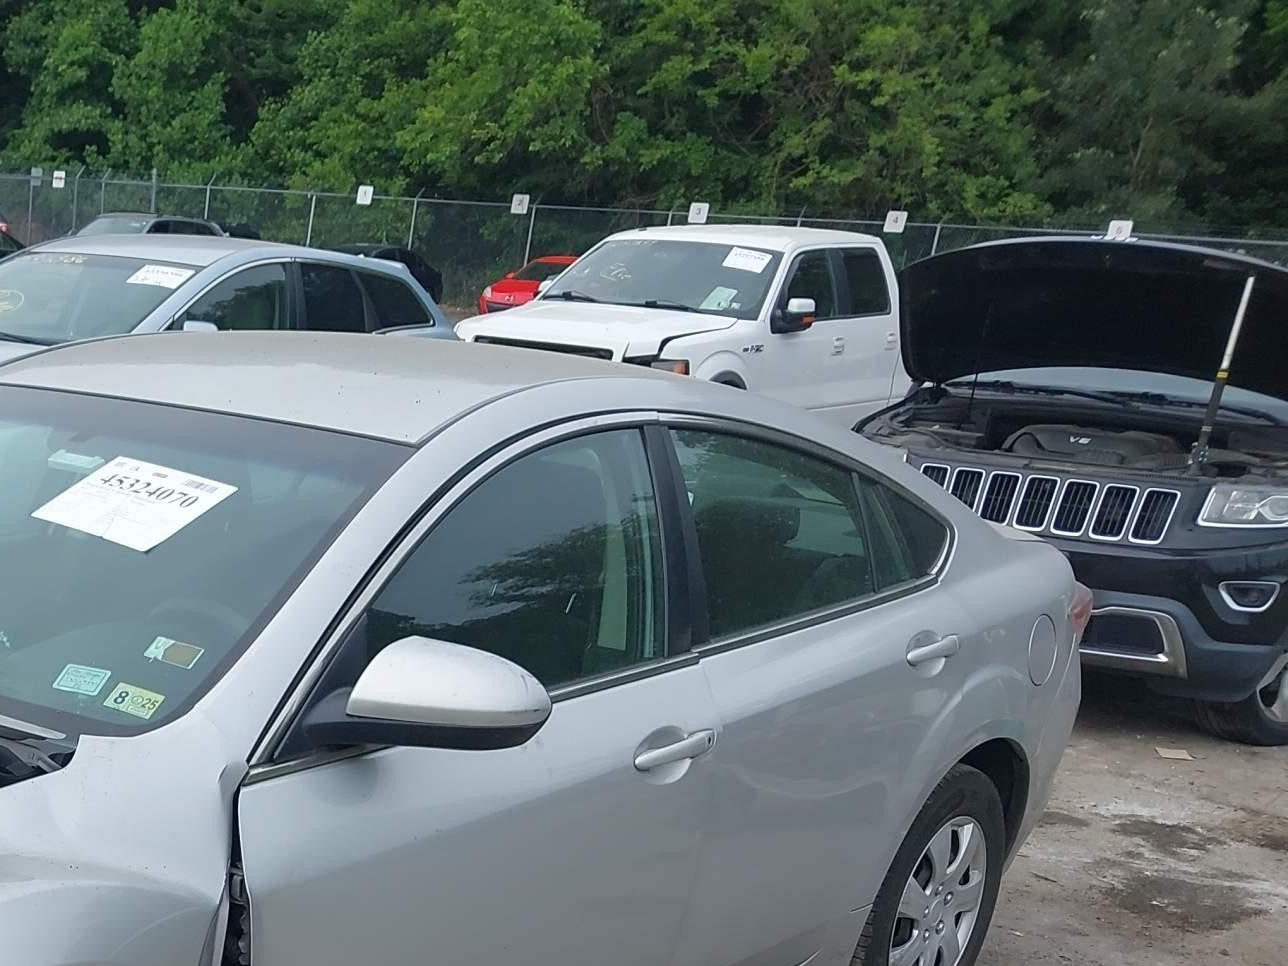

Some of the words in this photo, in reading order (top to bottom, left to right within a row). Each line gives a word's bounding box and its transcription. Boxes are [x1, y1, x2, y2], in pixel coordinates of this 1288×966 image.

[100, 473, 199, 508] 45324070
[113, 690, 129, 705] 8
[141, 697, 159, 711] 25
